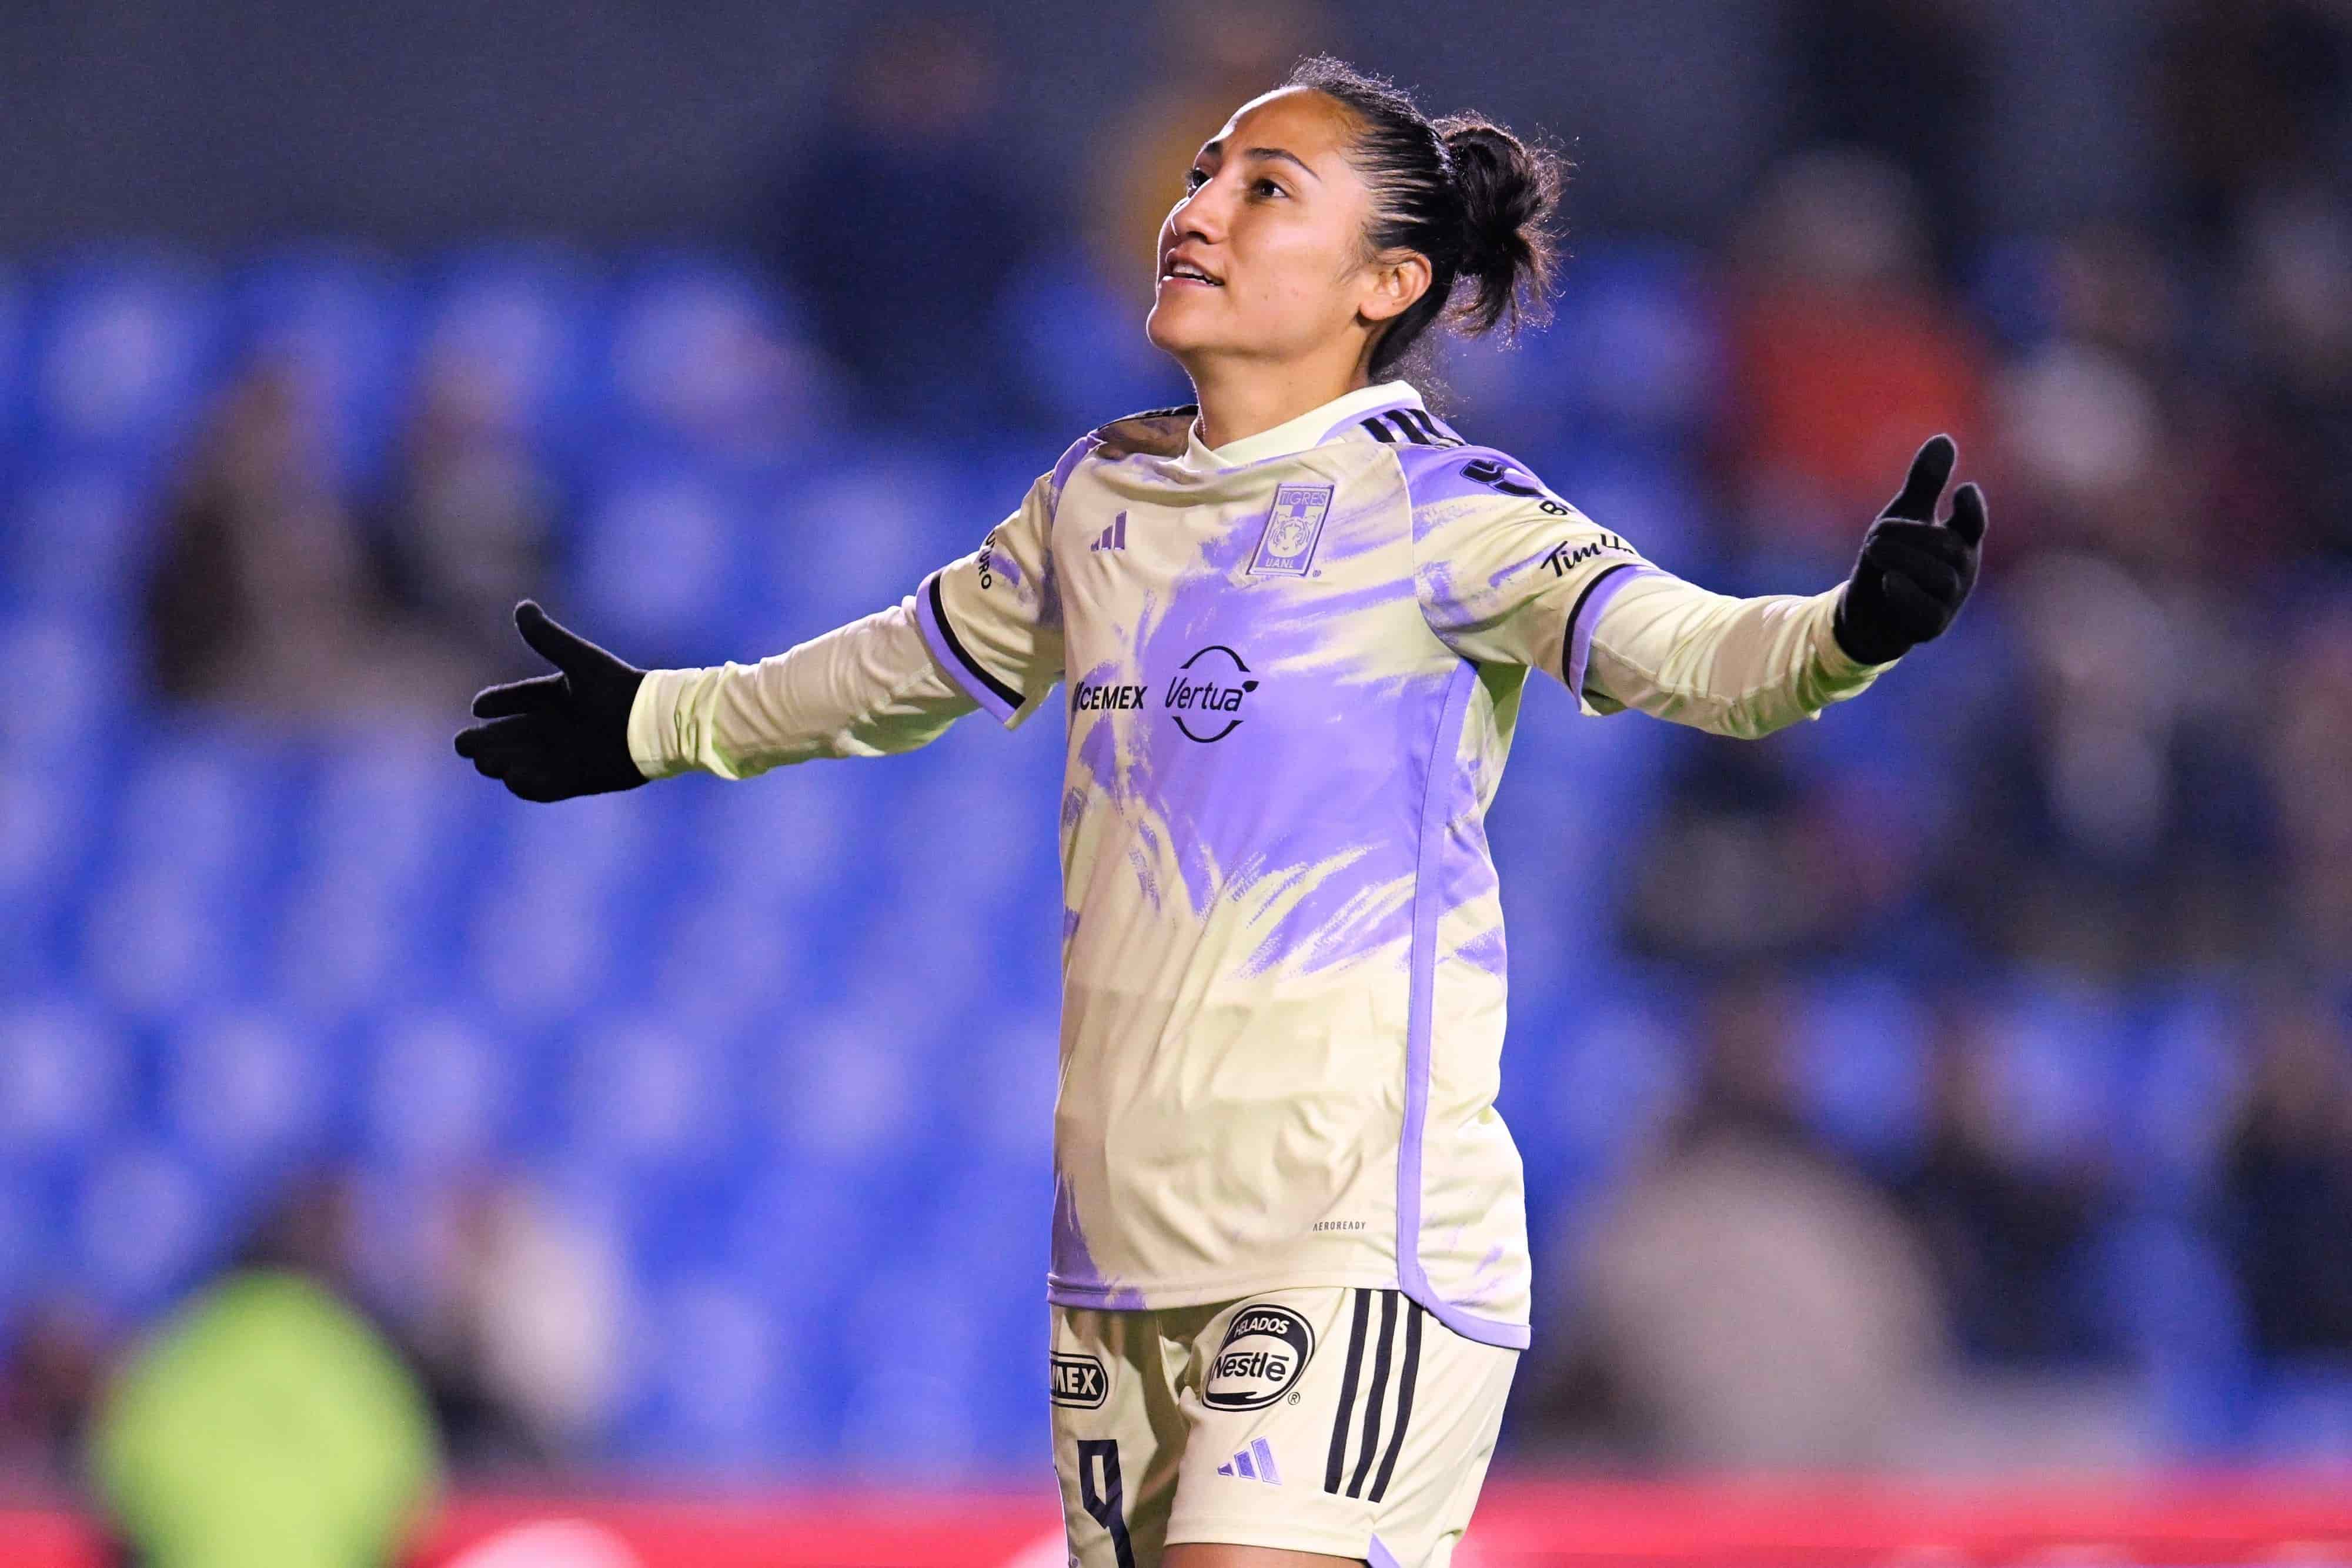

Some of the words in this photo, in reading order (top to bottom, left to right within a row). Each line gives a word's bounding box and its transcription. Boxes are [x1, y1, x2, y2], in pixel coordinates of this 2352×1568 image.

[1278, 491, 1328, 506] TIGRES
[1265, 558, 1295, 569] UANL
[1540, 540, 1602, 577] Tim
[1080, 686, 1148, 710] CEMEX
[1164, 676, 1244, 712] Vertua
[1312, 1221, 1367, 1232] AEROREADY
[1233, 1316, 1290, 1339] HELADOS
